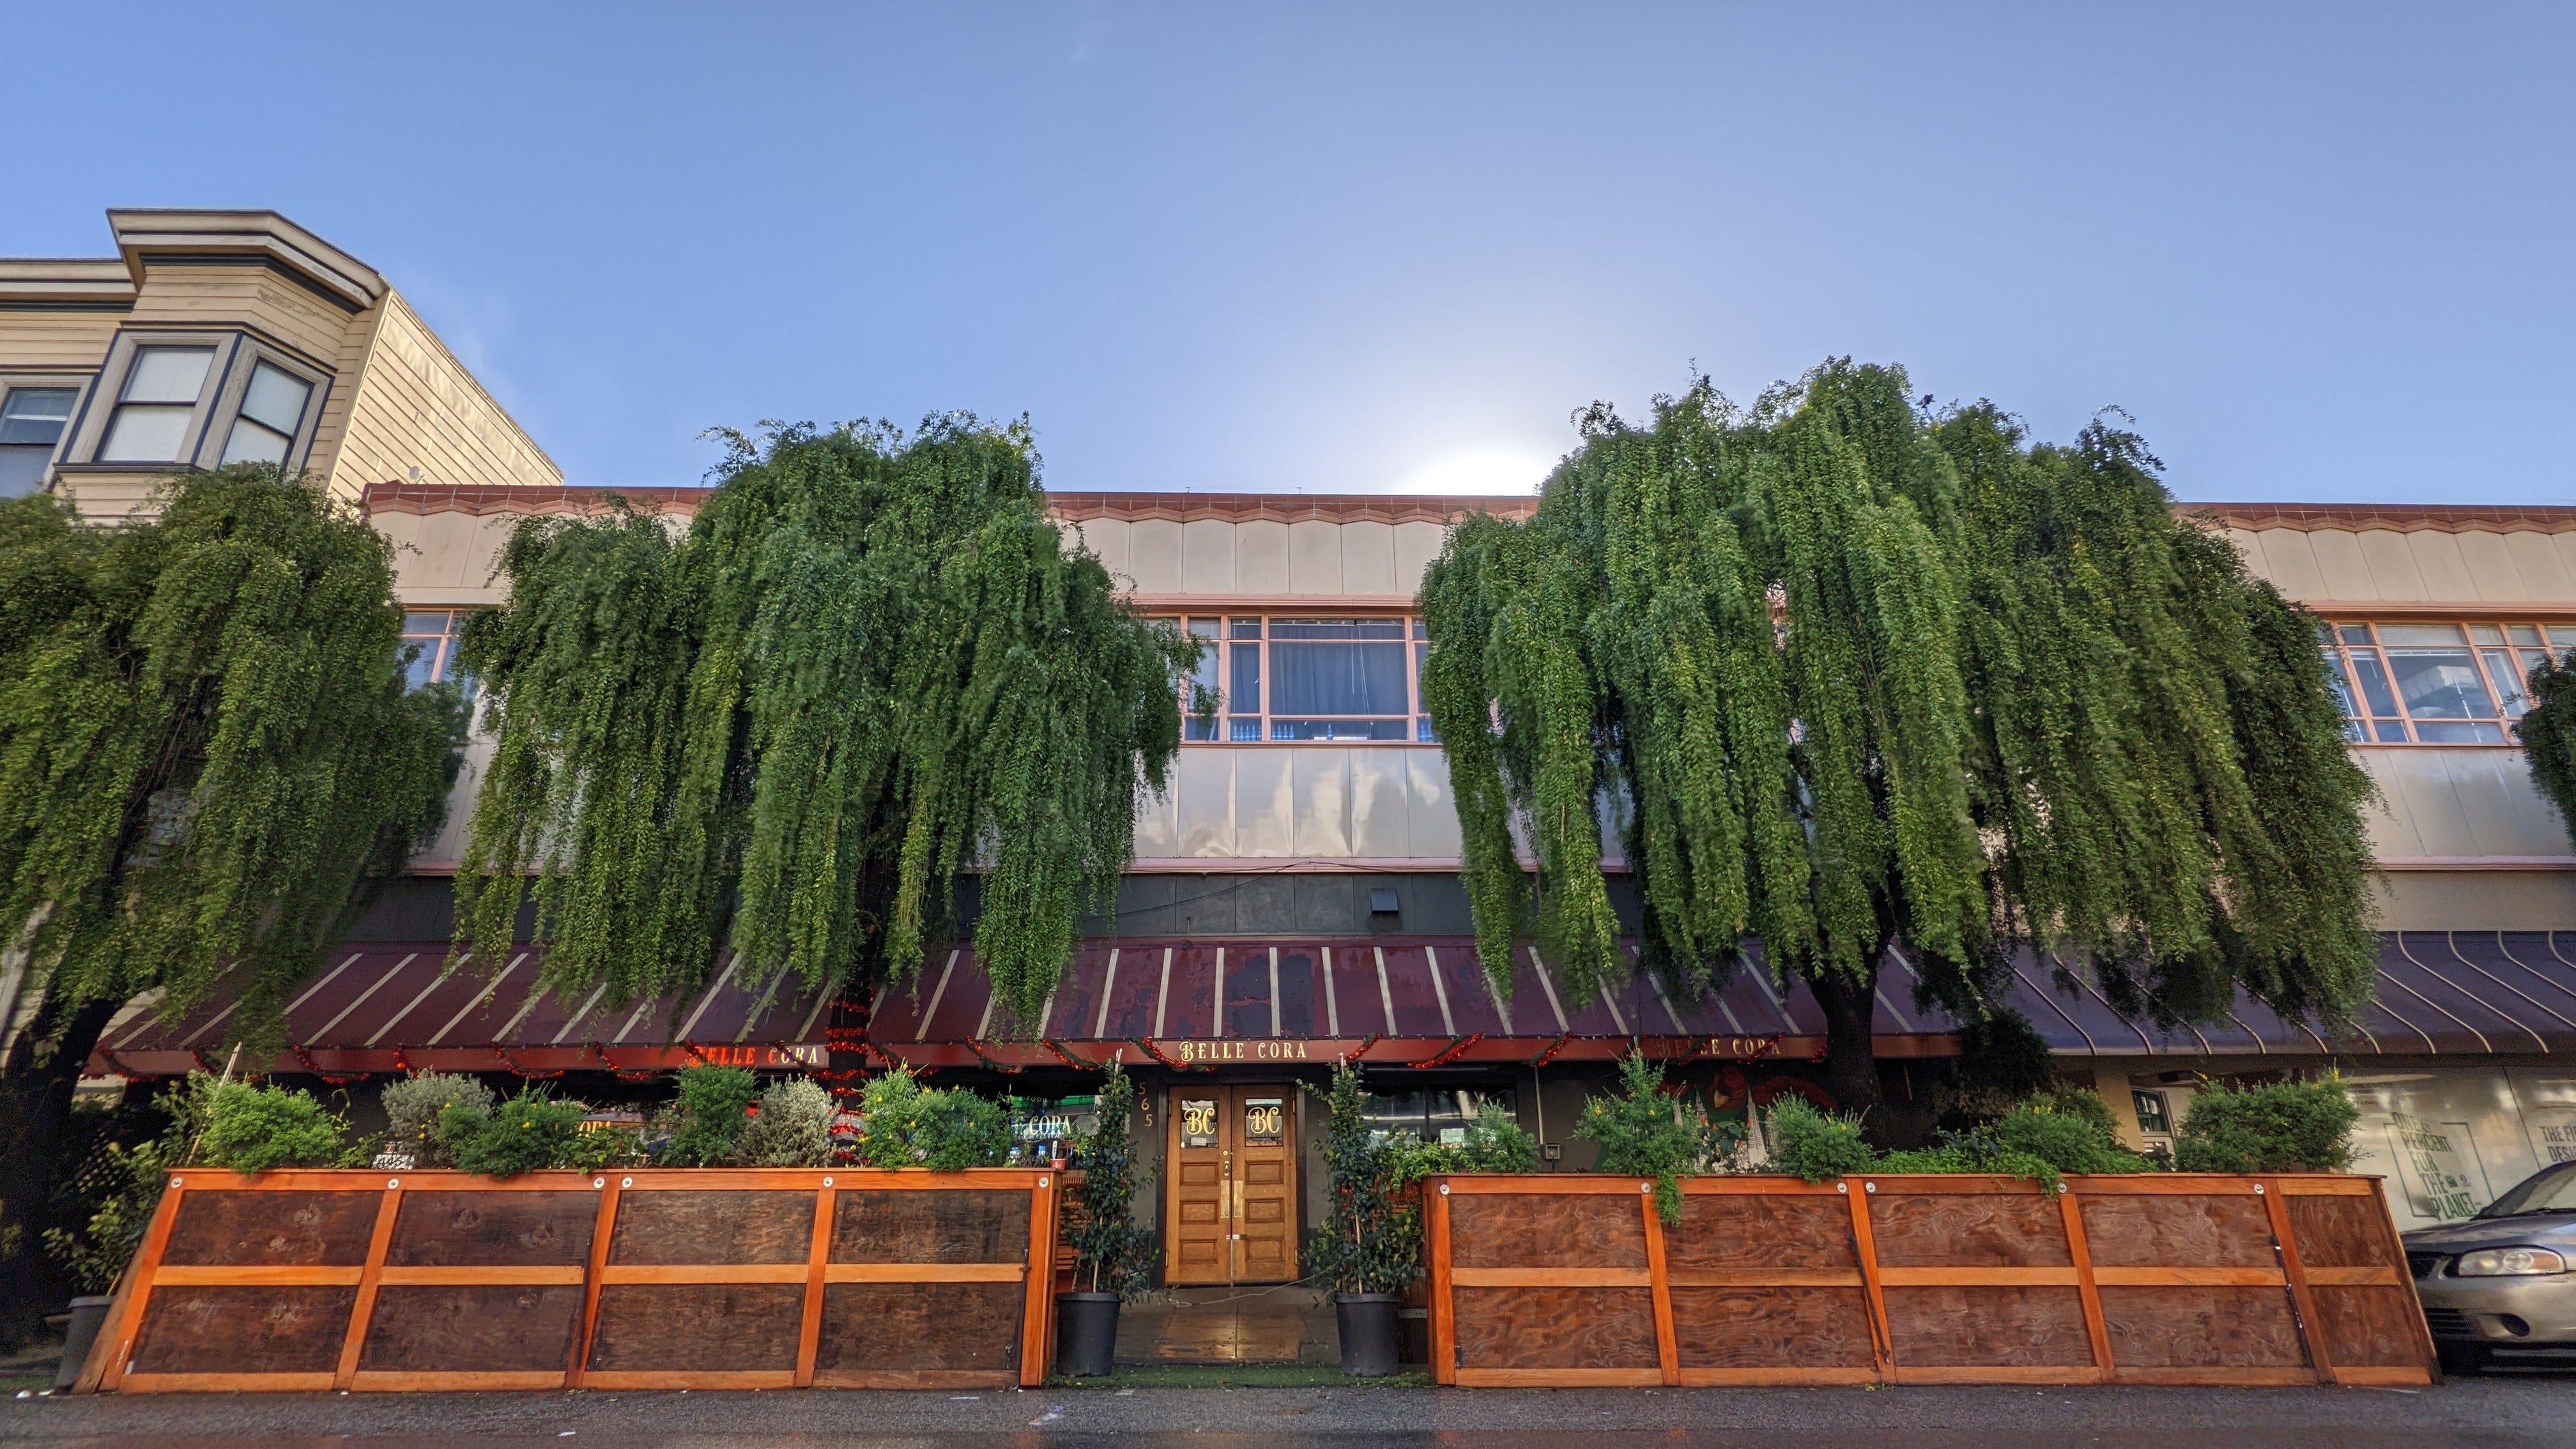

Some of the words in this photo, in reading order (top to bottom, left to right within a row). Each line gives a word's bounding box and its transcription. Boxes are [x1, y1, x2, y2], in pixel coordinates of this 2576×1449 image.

[1179, 1041, 1244, 1062] BELLE
[1258, 1042, 1306, 1058] CORA
[1029, 1115, 1071, 1136] CORA
[1184, 1108, 1215, 1135] BC
[1248, 1107, 1279, 1134] BC
[2400, 1131, 2453, 1153] PERCENT
[2539, 1126, 2564, 1142] THE
[2409, 1151, 2439, 1172] FOR
[2419, 1173, 2449, 1197] THE
[2428, 1192, 2478, 1221] PLANET
